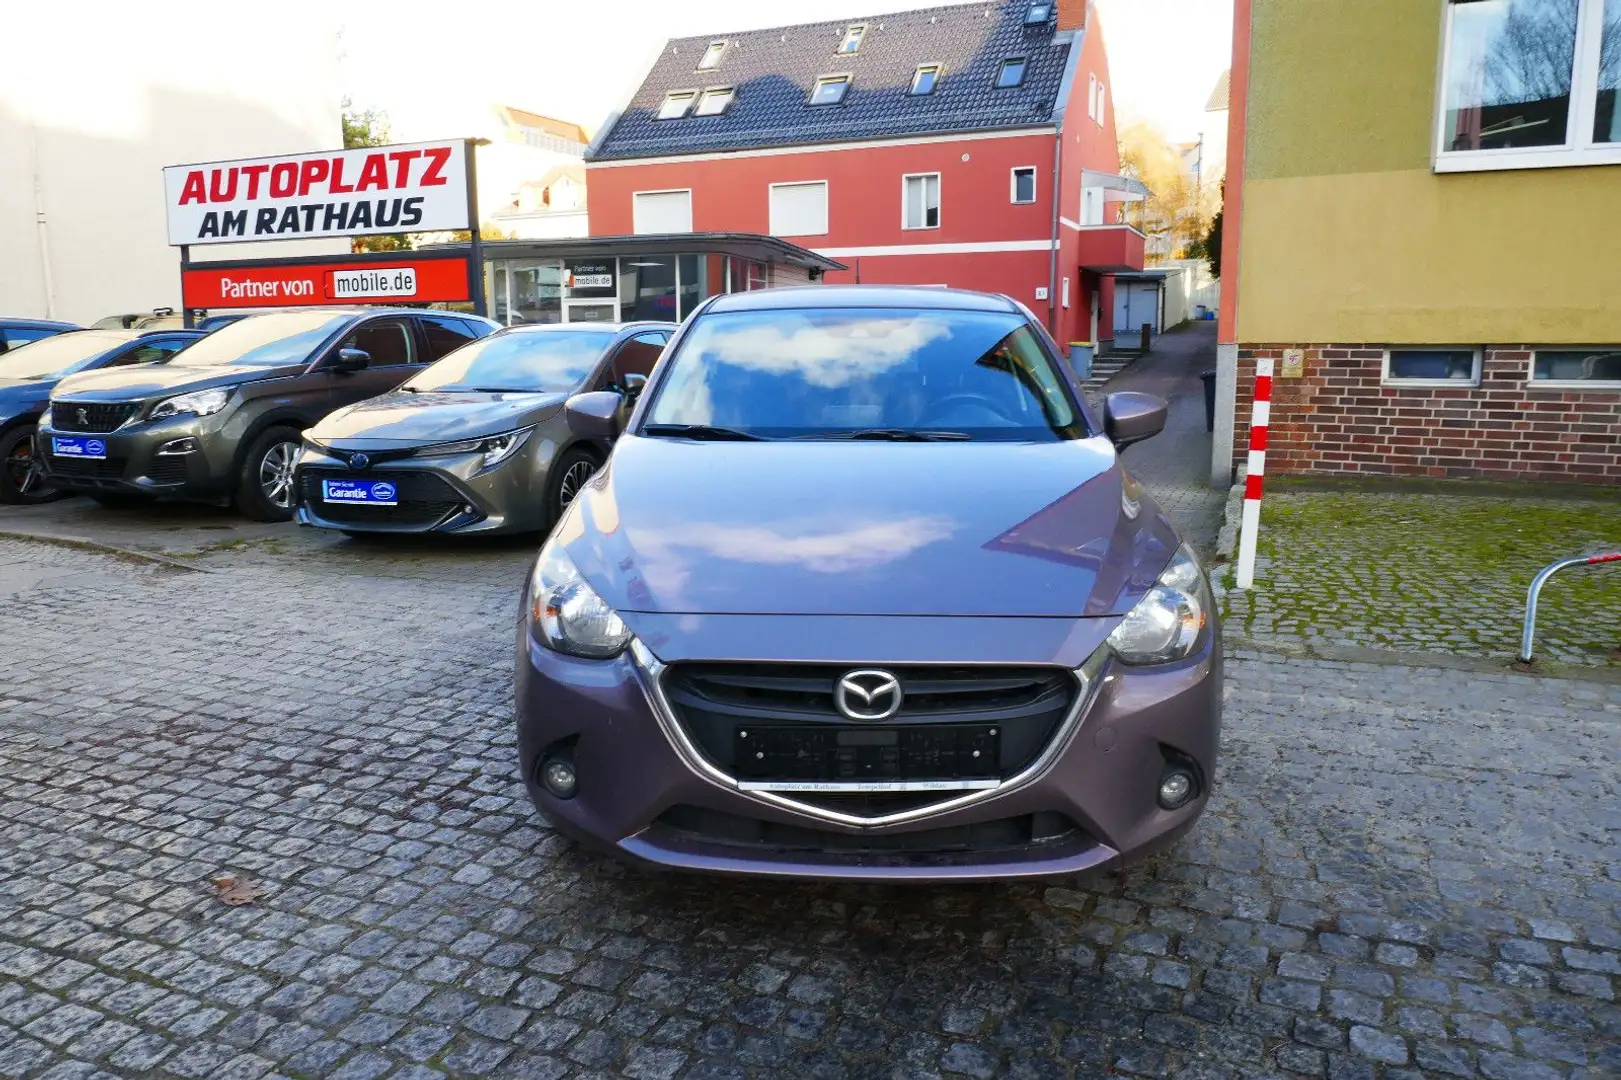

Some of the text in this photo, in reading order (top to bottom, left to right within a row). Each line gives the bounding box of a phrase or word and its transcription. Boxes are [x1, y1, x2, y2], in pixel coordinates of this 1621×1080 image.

[178, 147, 452, 205] AUTOPLATZ
[198, 197, 424, 238] AM RATHAUS
[221, 277, 314, 298] Partner von
[337, 271, 413, 293] mobile.de
[575, 275, 610, 285] mobile.de
[329, 487, 367, 499] Garantie
